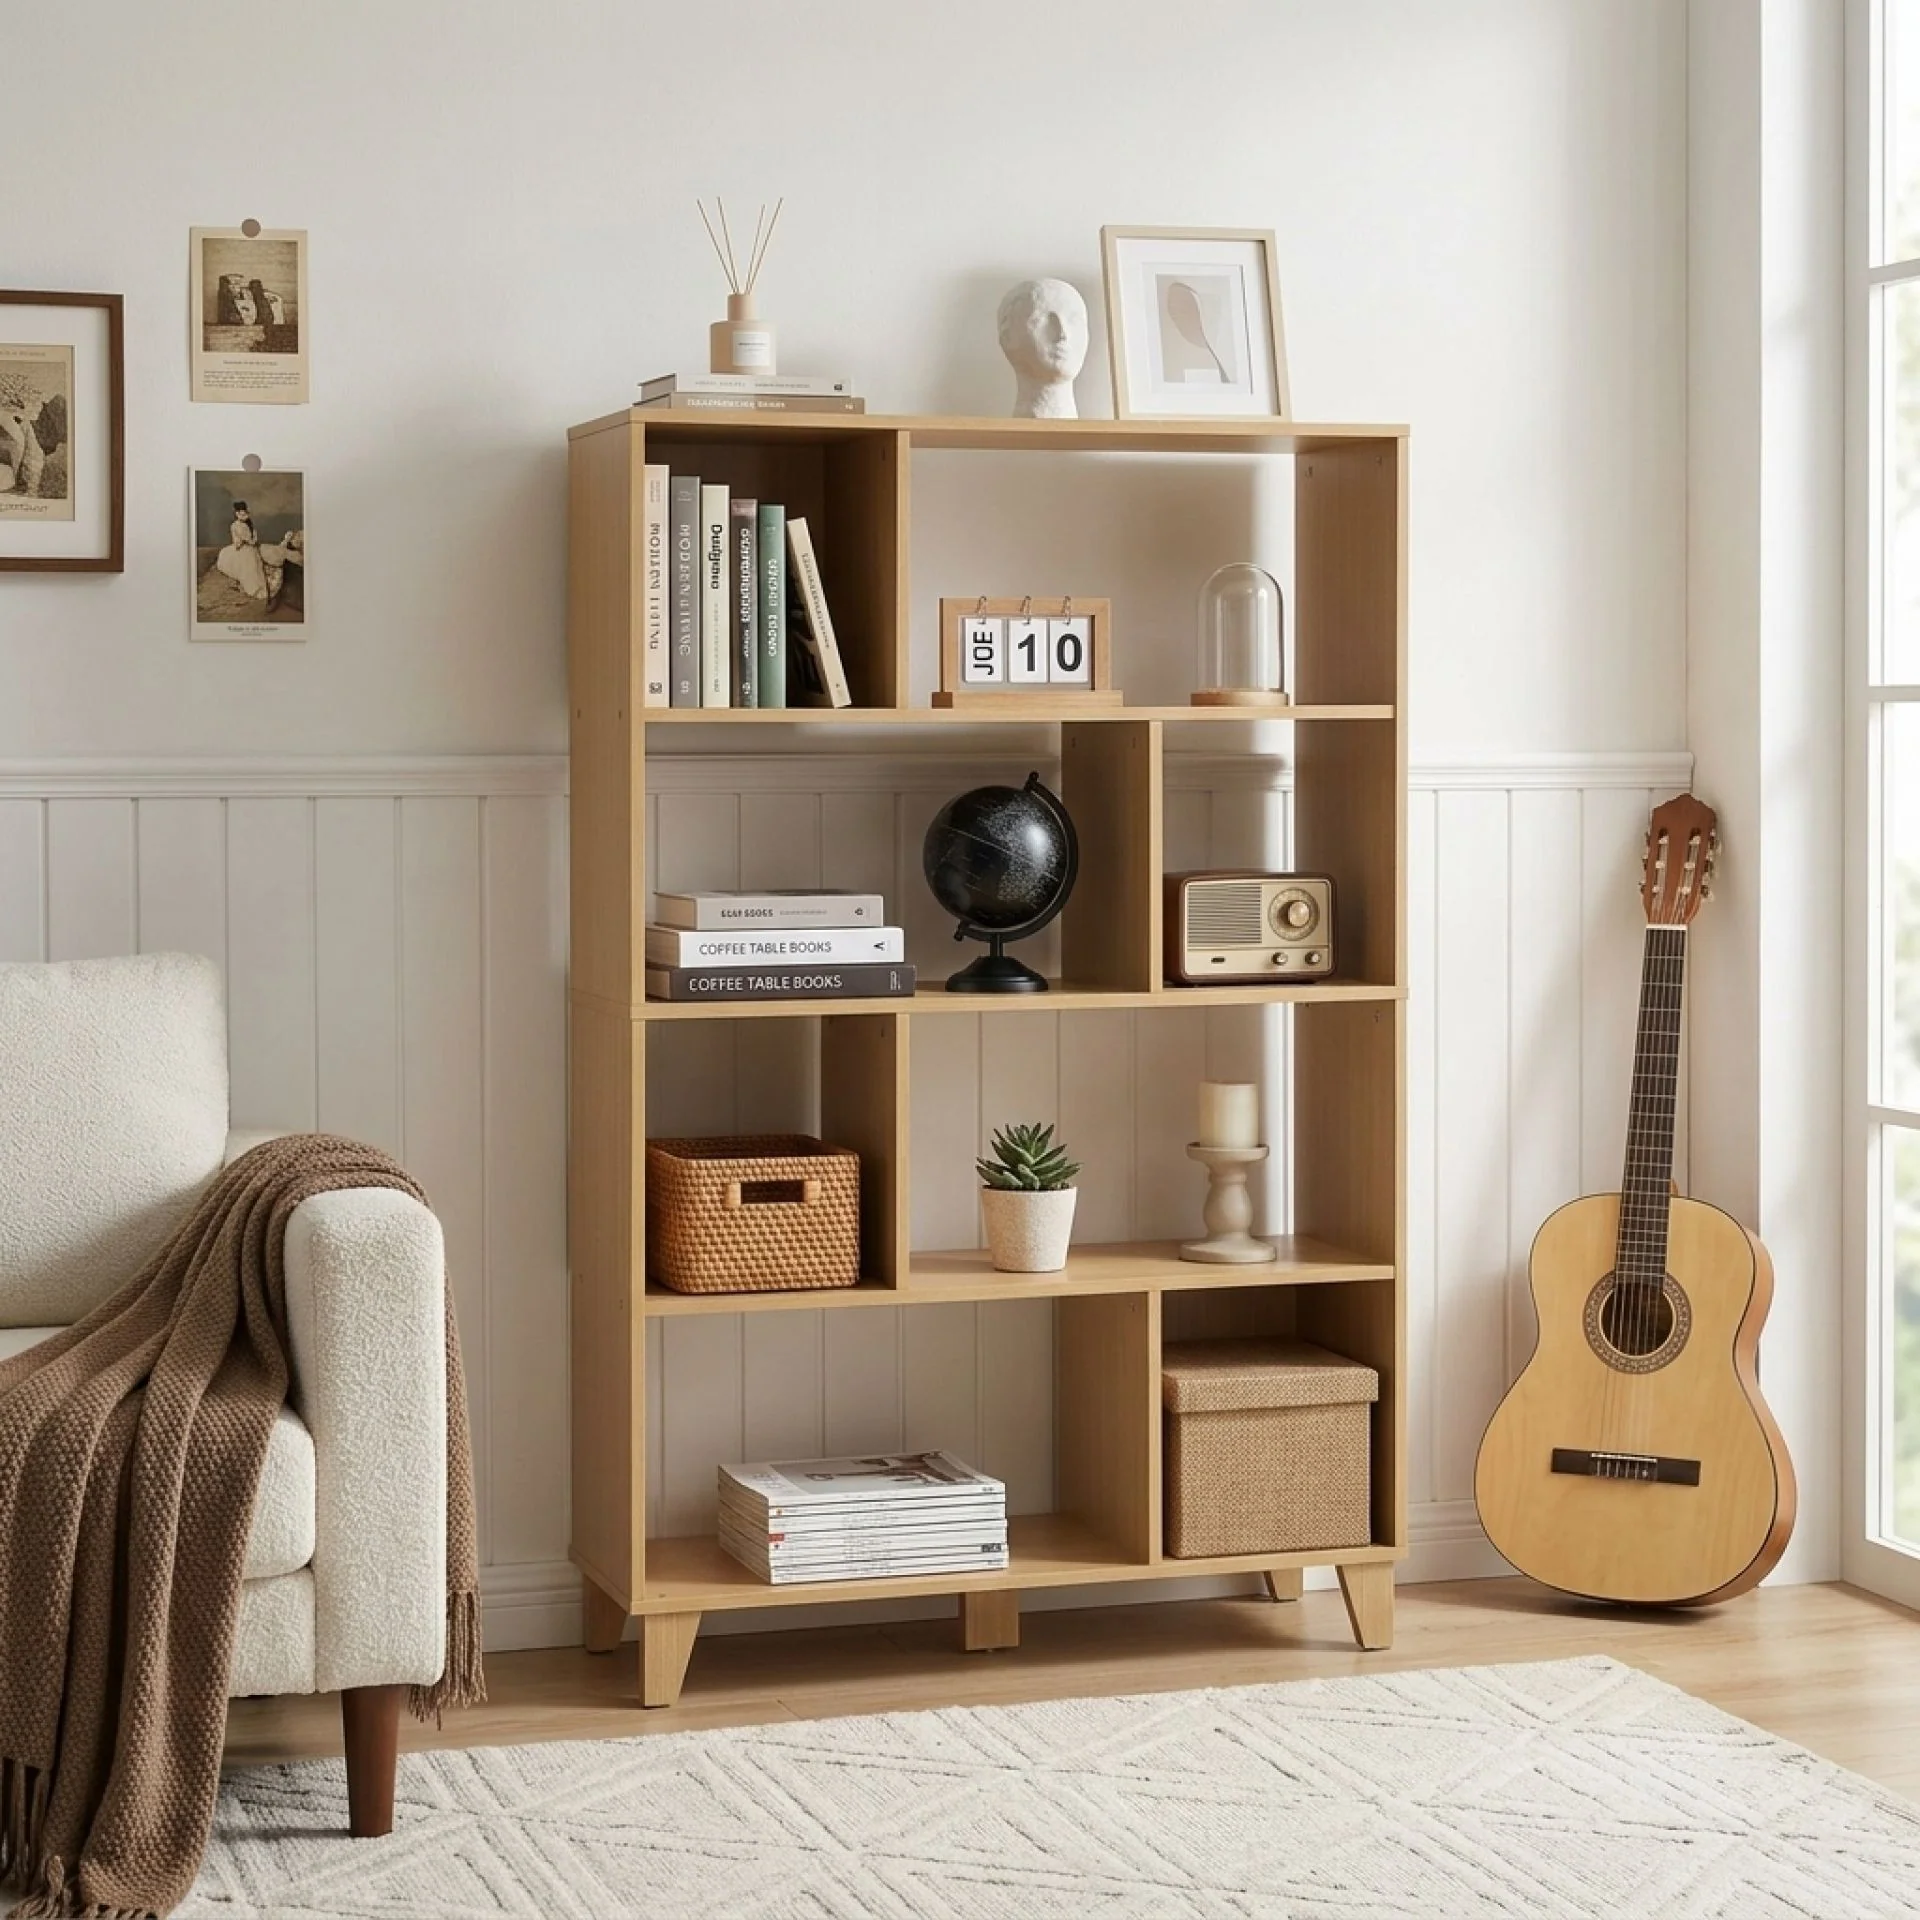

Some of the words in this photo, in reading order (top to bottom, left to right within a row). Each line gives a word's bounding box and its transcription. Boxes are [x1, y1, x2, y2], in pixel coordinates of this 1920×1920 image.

[972, 631, 994, 676] JOE
[698, 943, 746, 955] COFFEE
[749, 942, 787, 954] TABLE
[789, 940, 832, 953] BOOKS
[747, 975, 791, 990] TABLE
[792, 974, 843, 989] BOOKS
